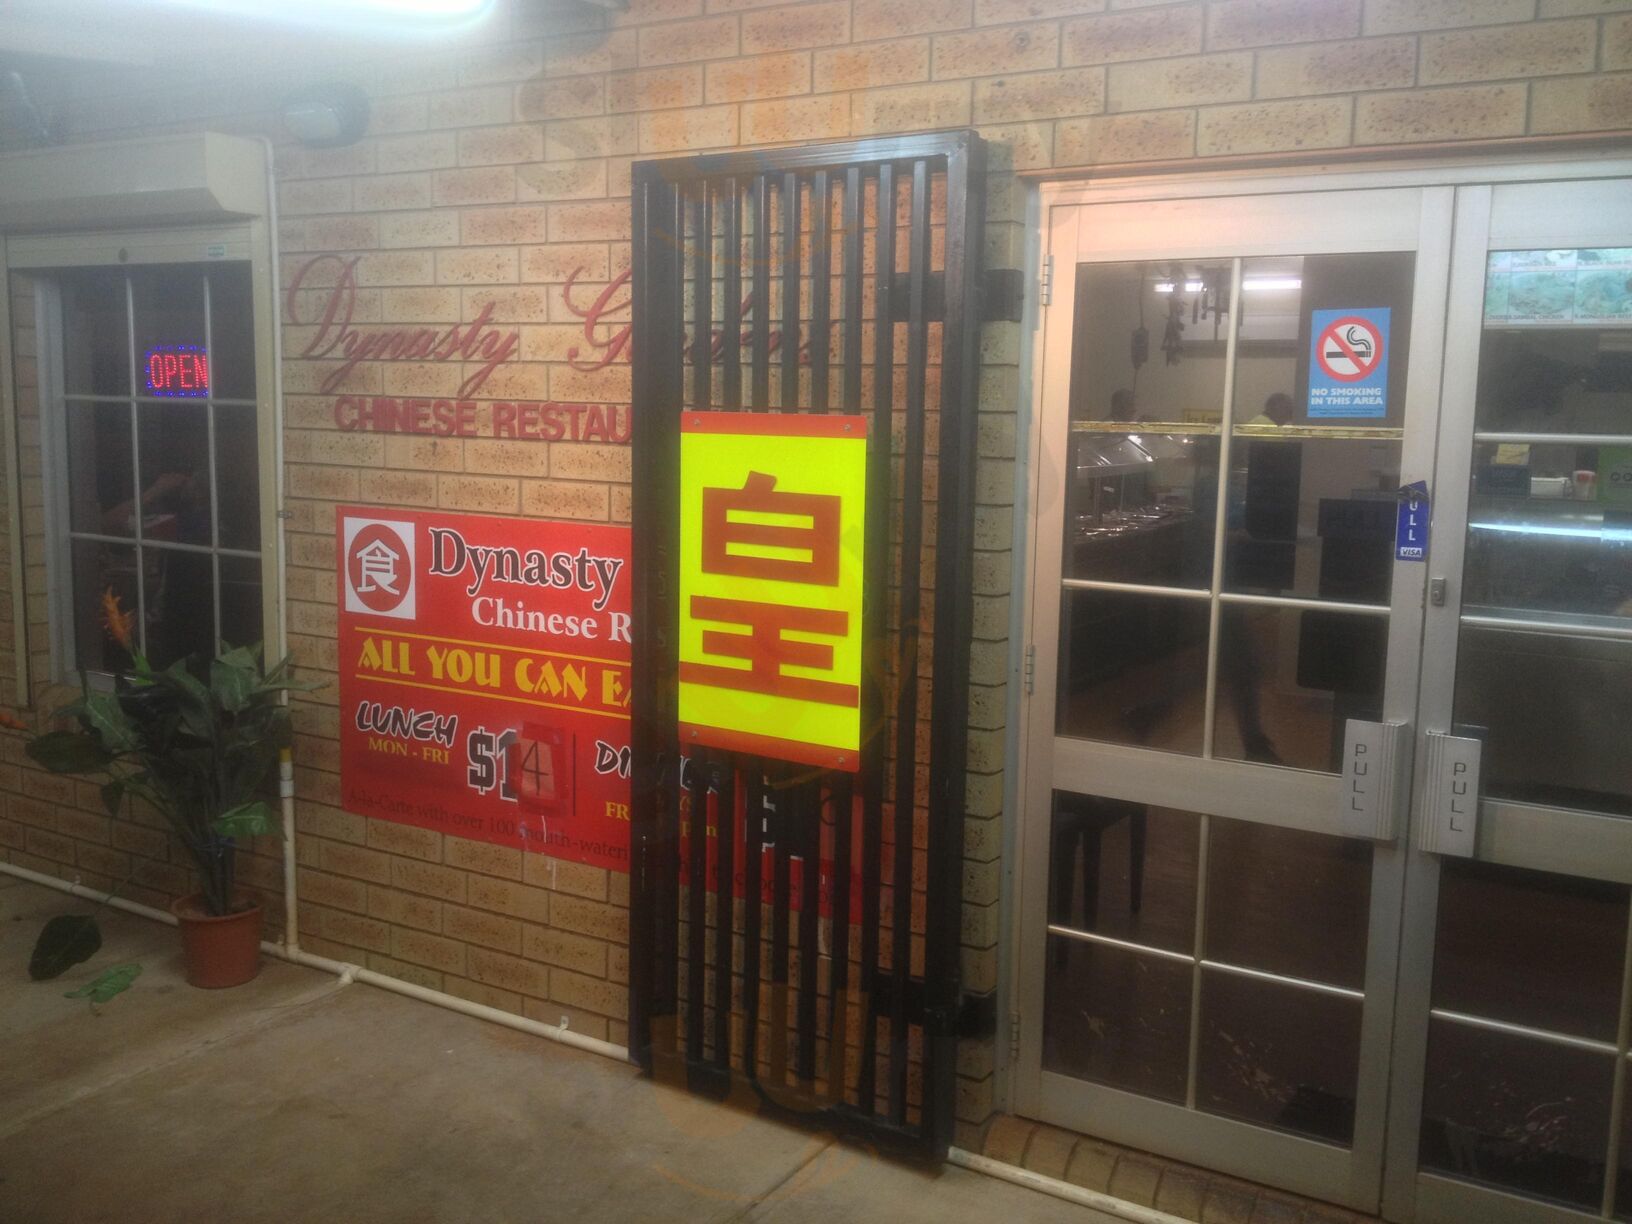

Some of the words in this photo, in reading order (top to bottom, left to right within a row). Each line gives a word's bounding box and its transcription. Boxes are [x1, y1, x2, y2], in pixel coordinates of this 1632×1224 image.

[287, 255, 517, 398] Dynasty
[150, 354, 208, 388] OPEN
[1311, 388, 1329, 396] NO
[1330, 387, 1382, 396] SMOKING
[334, 394, 477, 437] CHINESE
[493, 402, 632, 443] RESTAU
[1311, 397, 1324, 405] IN
[1327, 397, 1351, 405] THIS
[1353, 397, 1383, 405] AREA
[1408, 501, 1418, 541] ULL
[428, 525, 624, 612] Dynasty
[1402, 548, 1421, 556] VISA
[679, 470, 859, 709] 皇
[471, 596, 599, 640] Chinese
[357, 636, 416, 677] ALL
[426, 645, 500, 690] YOU
[514, 658, 589, 701] CAN
[355, 700, 459, 748] LUNCH
[368, 737, 408, 757] MON
[421, 747, 450, 766] FRI
[1351, 743, 1368, 812] PULL
[1450, 762, 1468, 832] PULL
[453, 812, 485, 829] over
[490, 817, 515, 836] 100
[604, 801, 631, 822] FR
